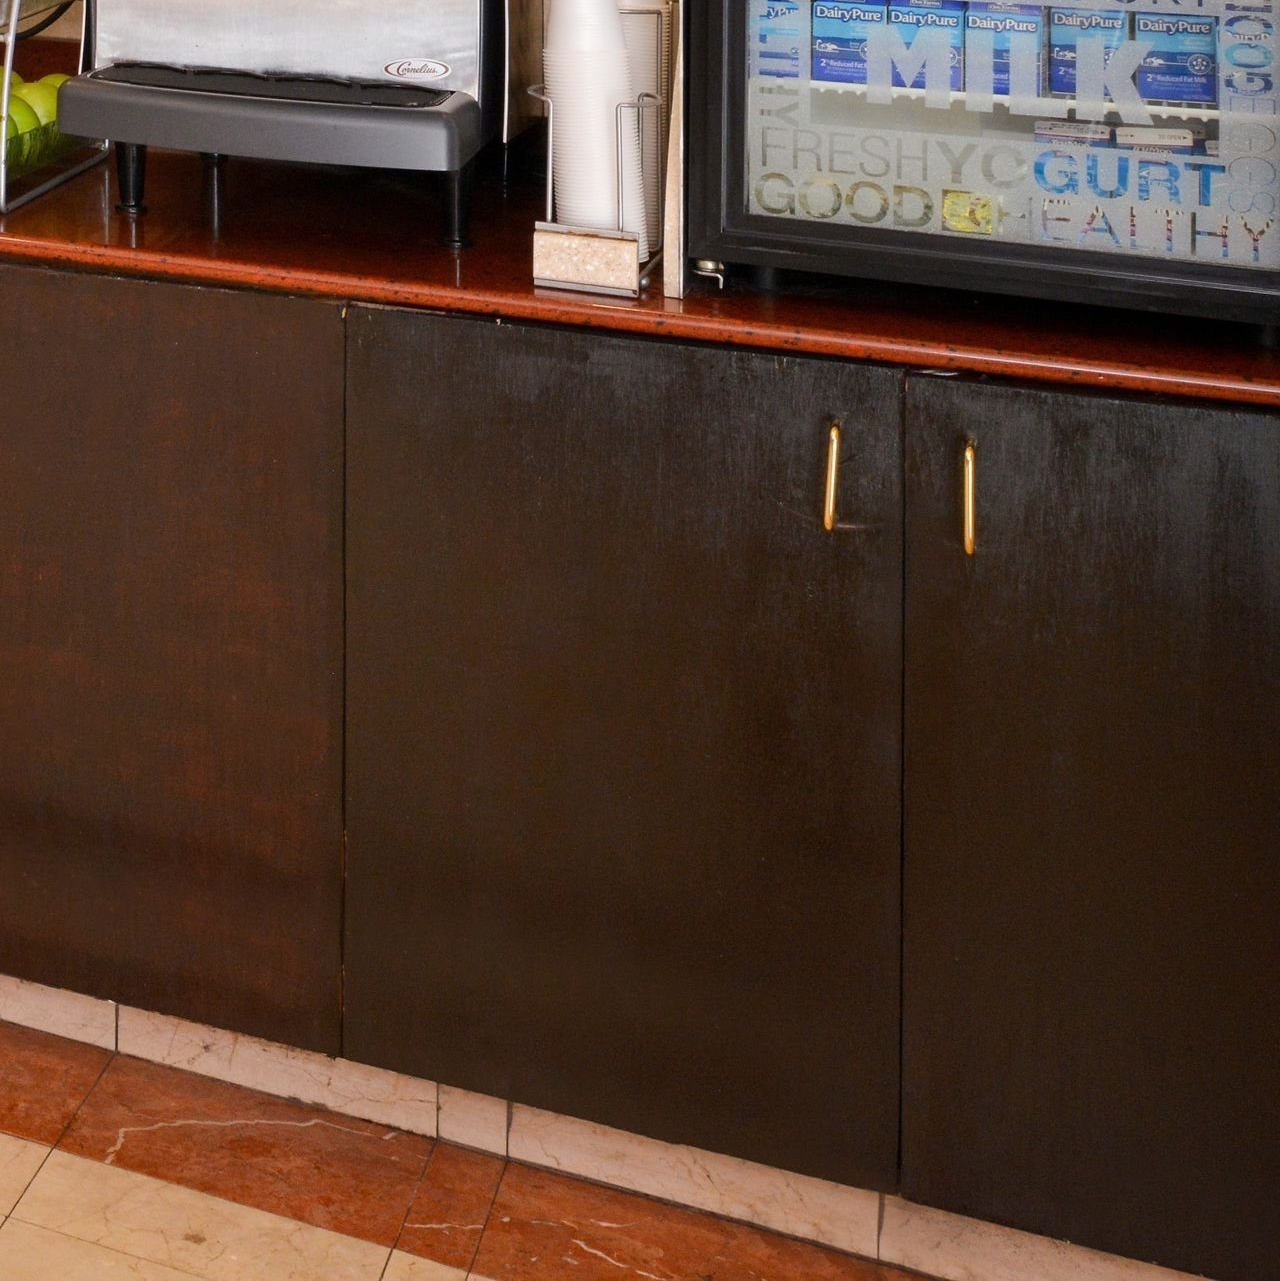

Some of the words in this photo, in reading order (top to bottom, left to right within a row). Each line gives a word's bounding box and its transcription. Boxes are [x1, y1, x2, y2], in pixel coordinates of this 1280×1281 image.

[816, 5, 881, 22] DairyPure
[890, 10, 958, 26] DairyPure
[1053, 13, 1122, 30] DairyPure
[968, 15, 1037, 32] DairyPure
[1139, 19, 1210, 35] DairyPure
[396, 61, 438, 76] Cornelius
[866, 23, 1155, 125] MILK
